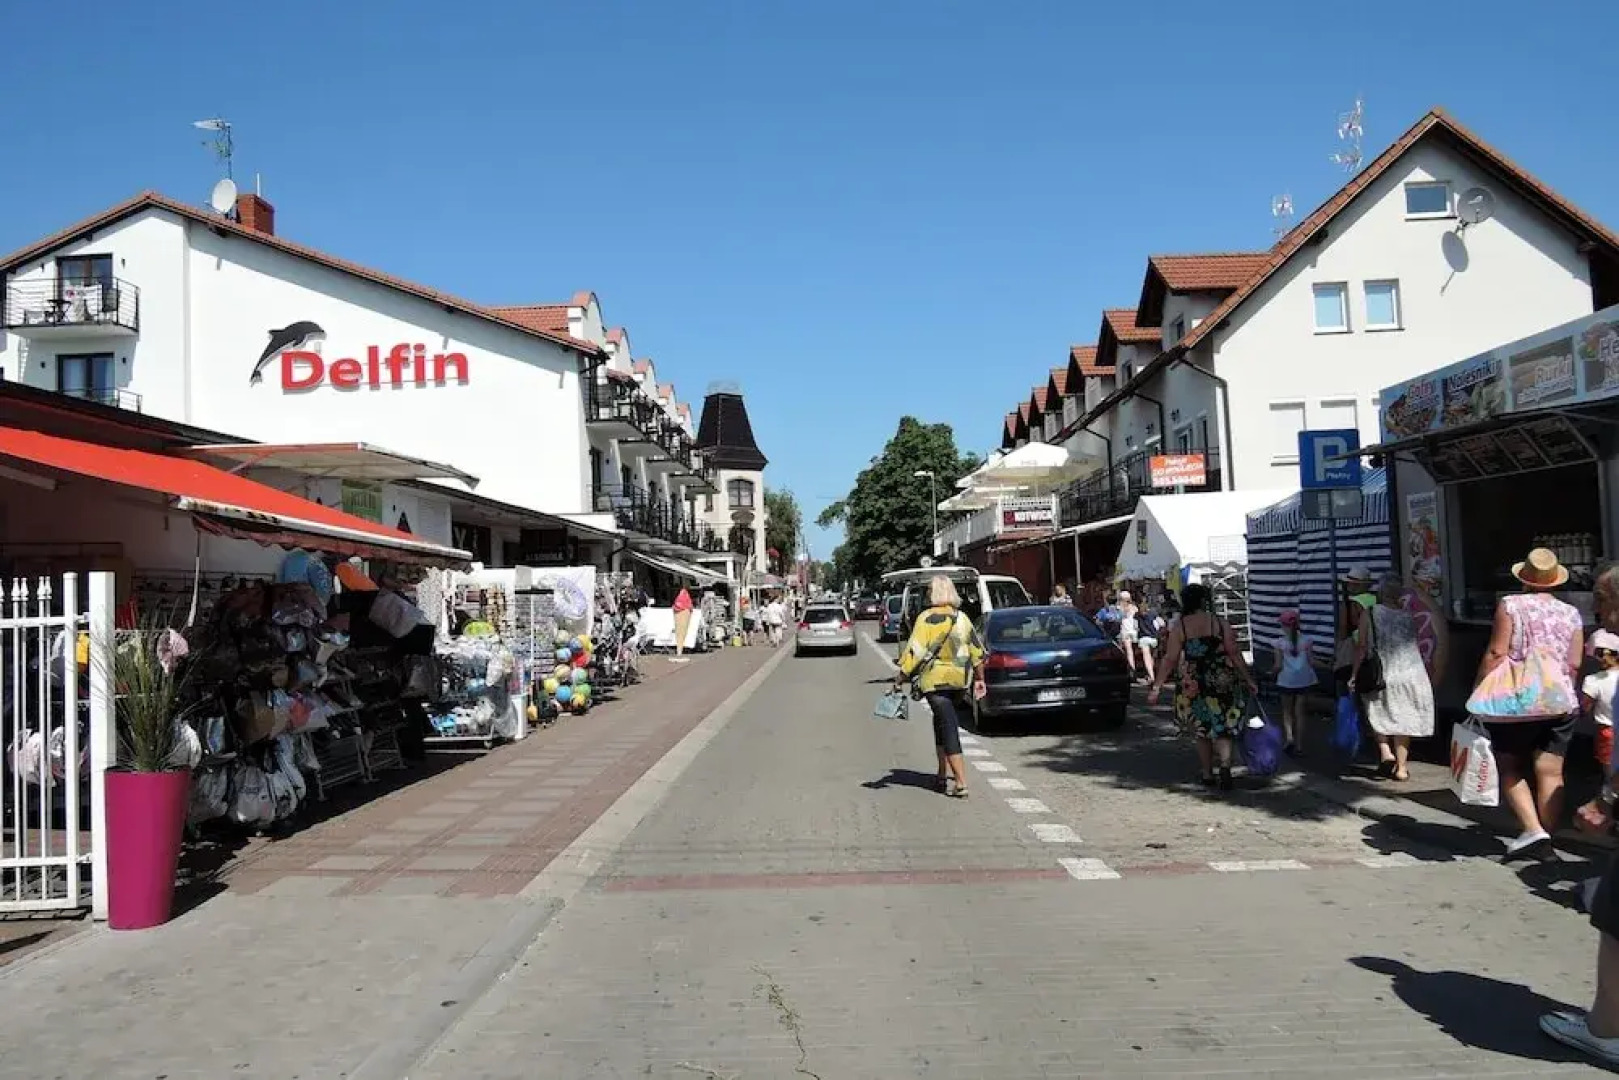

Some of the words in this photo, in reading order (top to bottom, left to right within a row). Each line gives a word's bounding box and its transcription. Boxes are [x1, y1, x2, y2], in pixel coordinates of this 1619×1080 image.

[281, 343, 469, 391] Delfin
[1313, 436, 1347, 481] P
[1014, 509, 1052, 522] KOTWICA
